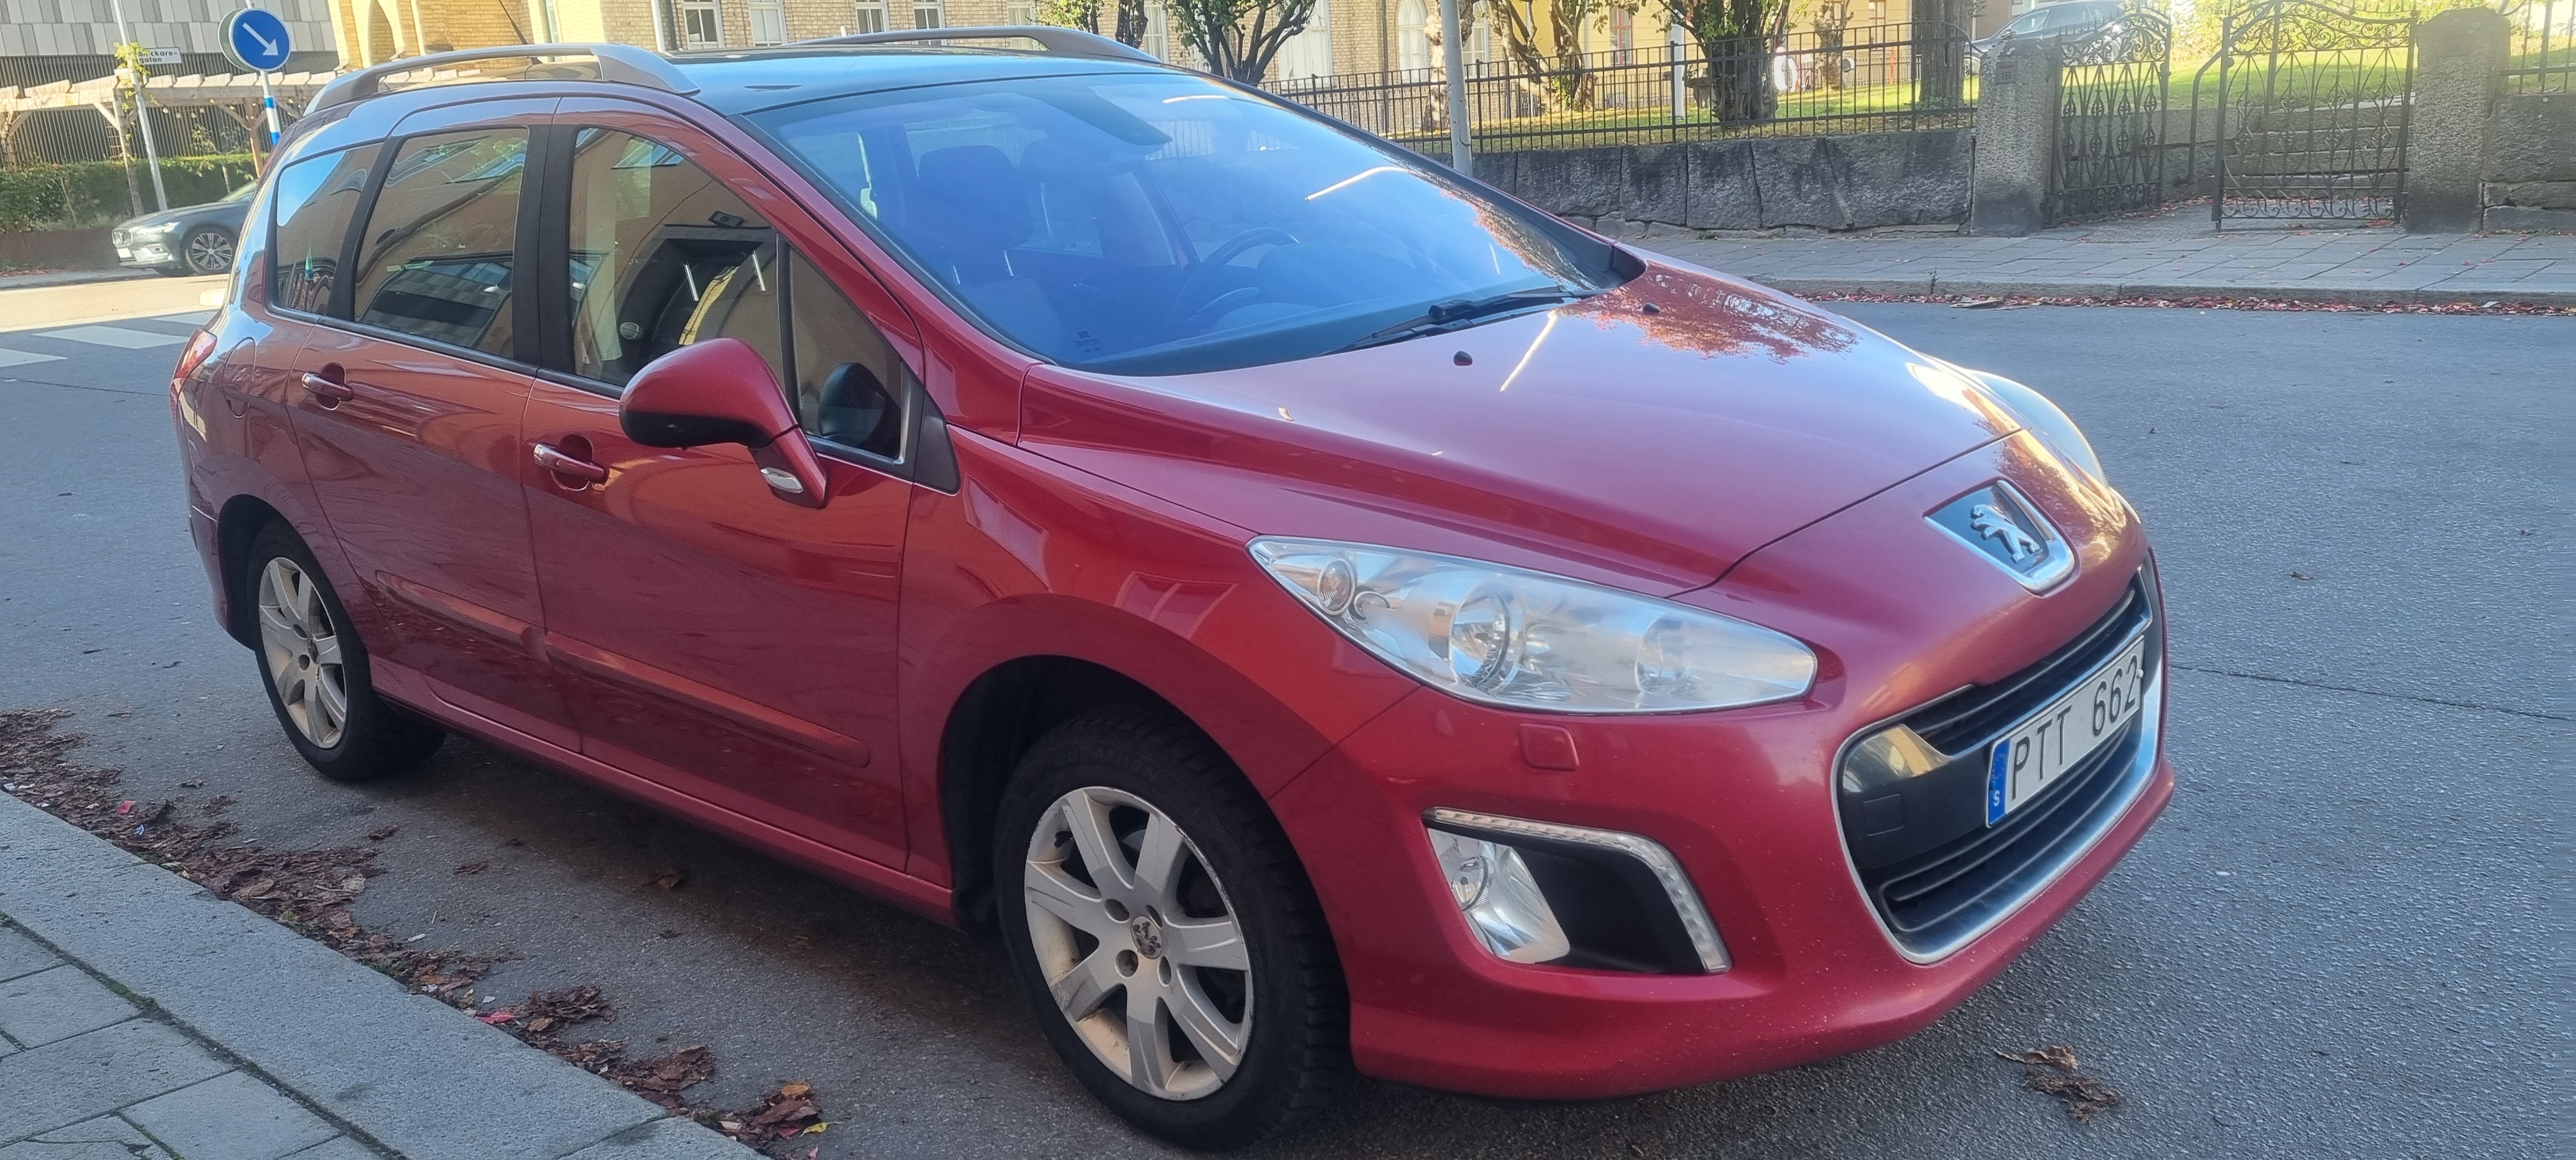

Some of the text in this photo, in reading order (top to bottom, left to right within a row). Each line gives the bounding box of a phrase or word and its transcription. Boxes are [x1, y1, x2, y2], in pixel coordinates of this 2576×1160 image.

[2012, 655, 2138, 801] PTT 662
[1993, 790, 2000, 807] S
